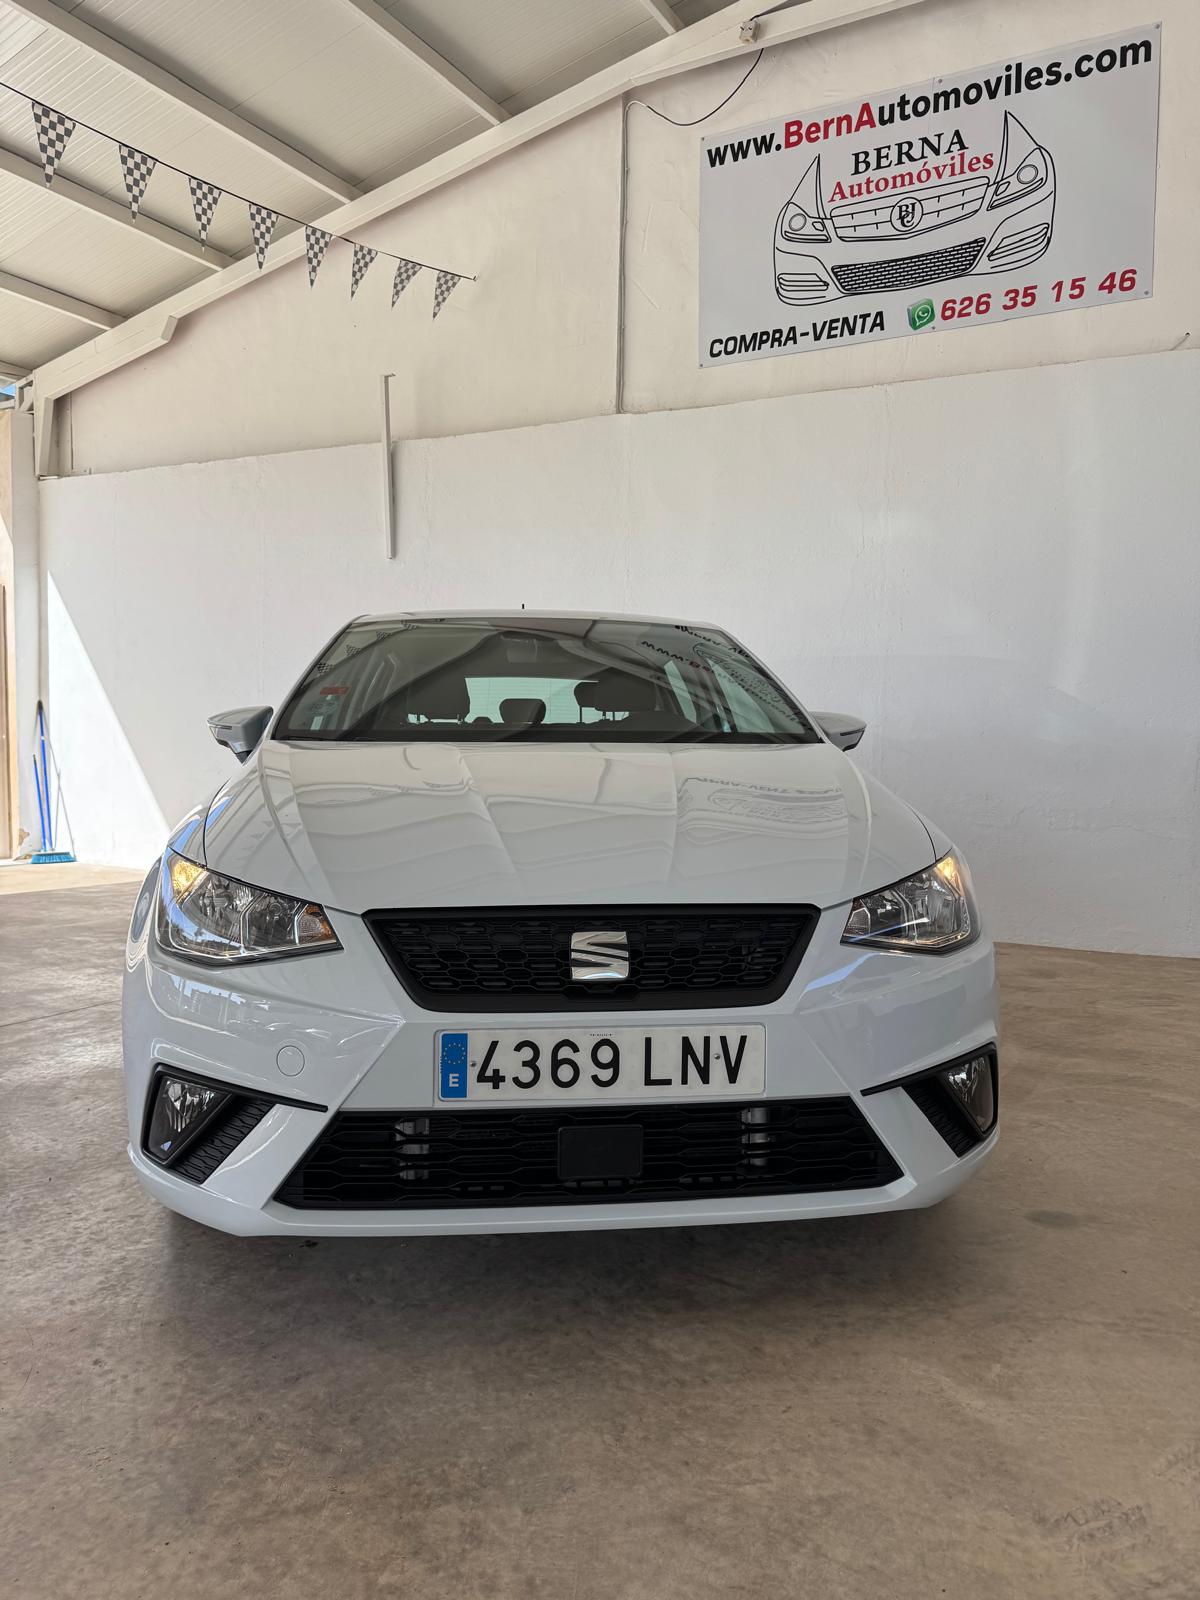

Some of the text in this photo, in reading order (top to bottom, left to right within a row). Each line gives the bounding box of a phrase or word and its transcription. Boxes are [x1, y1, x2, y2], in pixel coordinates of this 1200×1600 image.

[707, 39, 1152, 168] www.BernAutomoviles.com
[827, 151, 994, 203] Automóviles
[850, 129, 969, 176] BERNA
[940, 269, 1137, 321] 626 35 15 46
[709, 310, 885, 358] COMPRA-VENTA
[449, 1035, 747, 1089] E 4369 LNV
